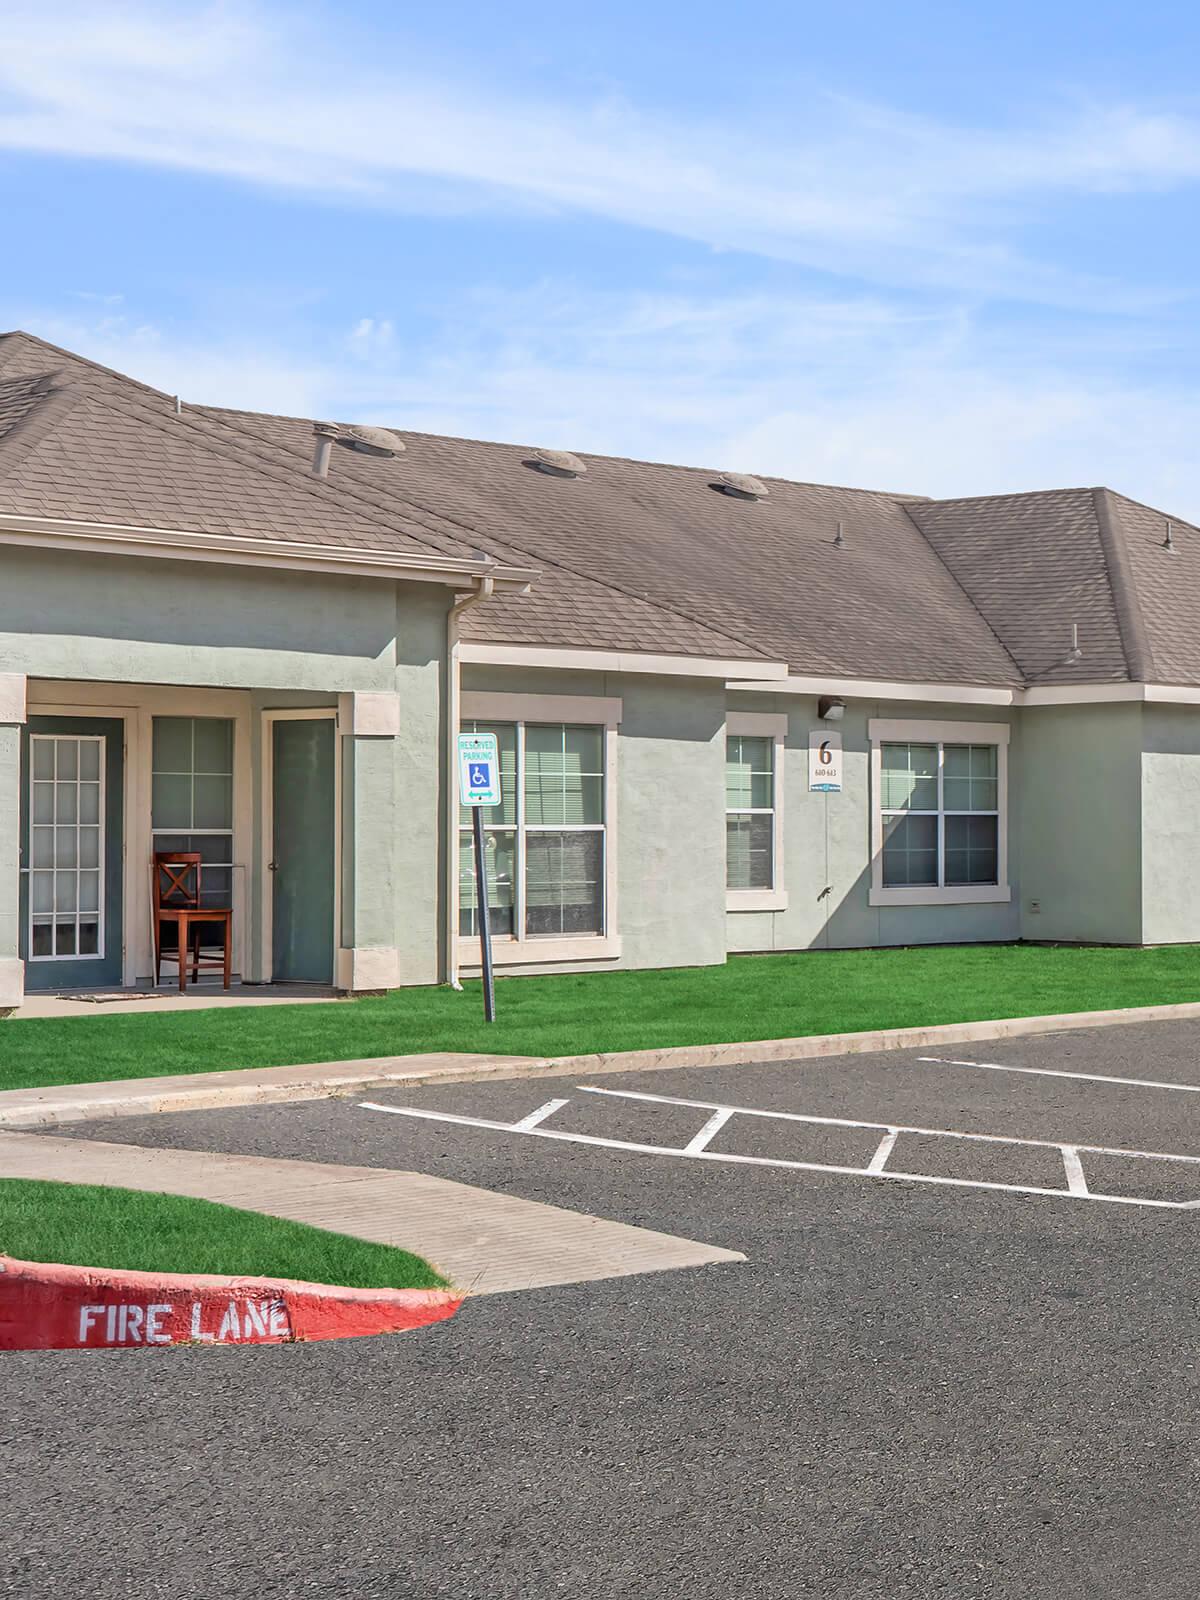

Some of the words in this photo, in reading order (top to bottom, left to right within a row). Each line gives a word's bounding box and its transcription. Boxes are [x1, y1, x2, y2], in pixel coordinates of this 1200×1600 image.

[460, 741, 494, 749] RESERVED
[819, 740, 832, 765] 6
[463, 752, 493, 760] PARKING
[79, 1303, 172, 1343] FIRE
[191, 1298, 292, 1341] LANE
